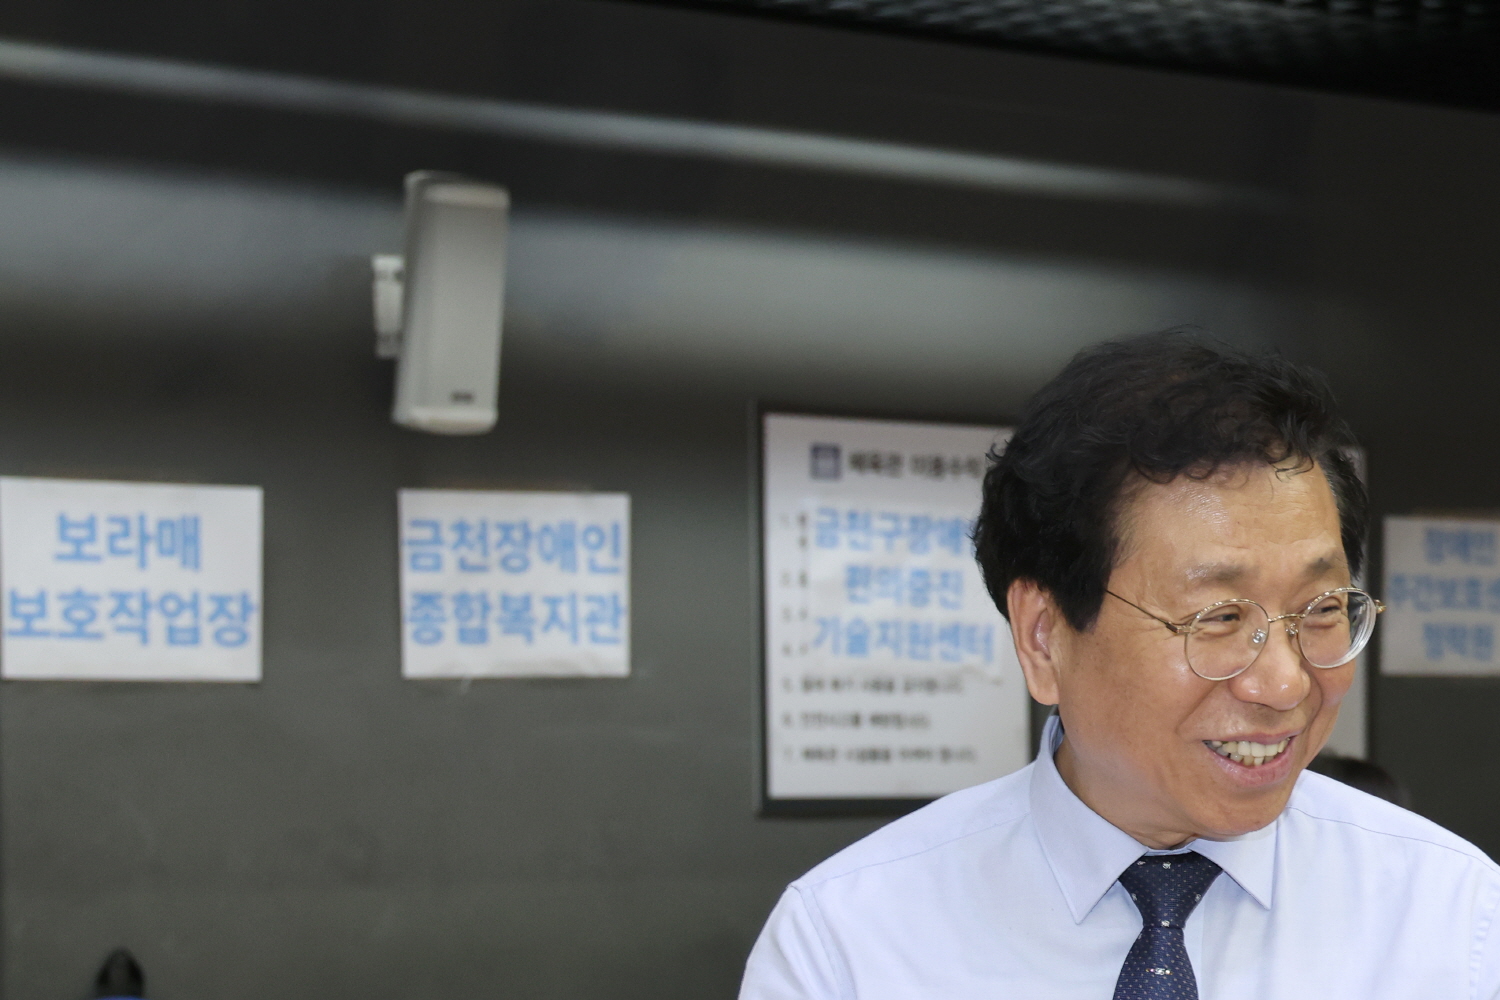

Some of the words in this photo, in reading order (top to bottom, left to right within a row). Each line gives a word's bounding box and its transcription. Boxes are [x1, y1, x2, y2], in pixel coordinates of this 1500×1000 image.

[54, 512, 201, 570] 보라매
[403, 518, 622, 574] 금천장애인
[815, 507, 977, 555] 금천구장애
[6, 588, 257, 647] 보호작업장
[405, 591, 625, 645] 종합복지관
[814, 616, 995, 664] 기술지원센터
